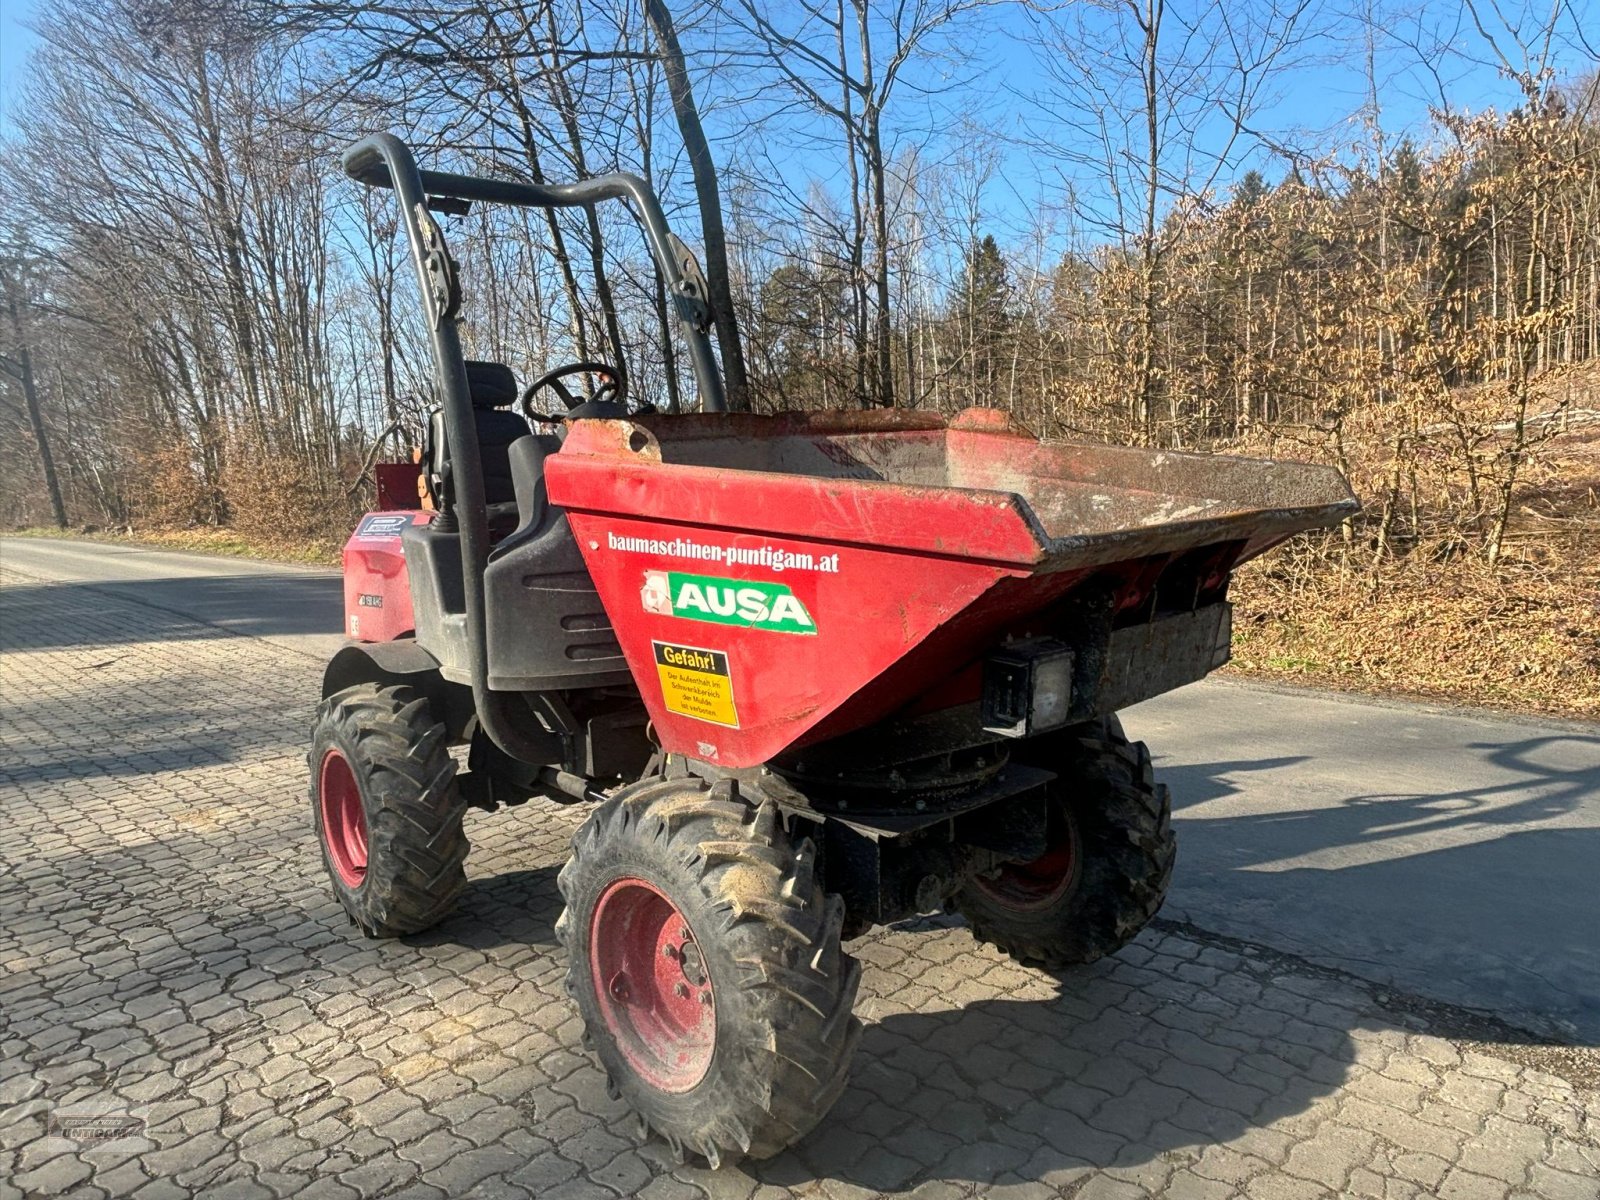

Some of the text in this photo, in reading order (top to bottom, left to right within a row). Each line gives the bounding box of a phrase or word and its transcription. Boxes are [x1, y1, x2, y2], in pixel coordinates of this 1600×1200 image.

[608, 532, 839, 573] baumaschinen-puntigam.at
[676, 582, 813, 626] AUSA
[663, 646, 716, 670] Gefahr!
